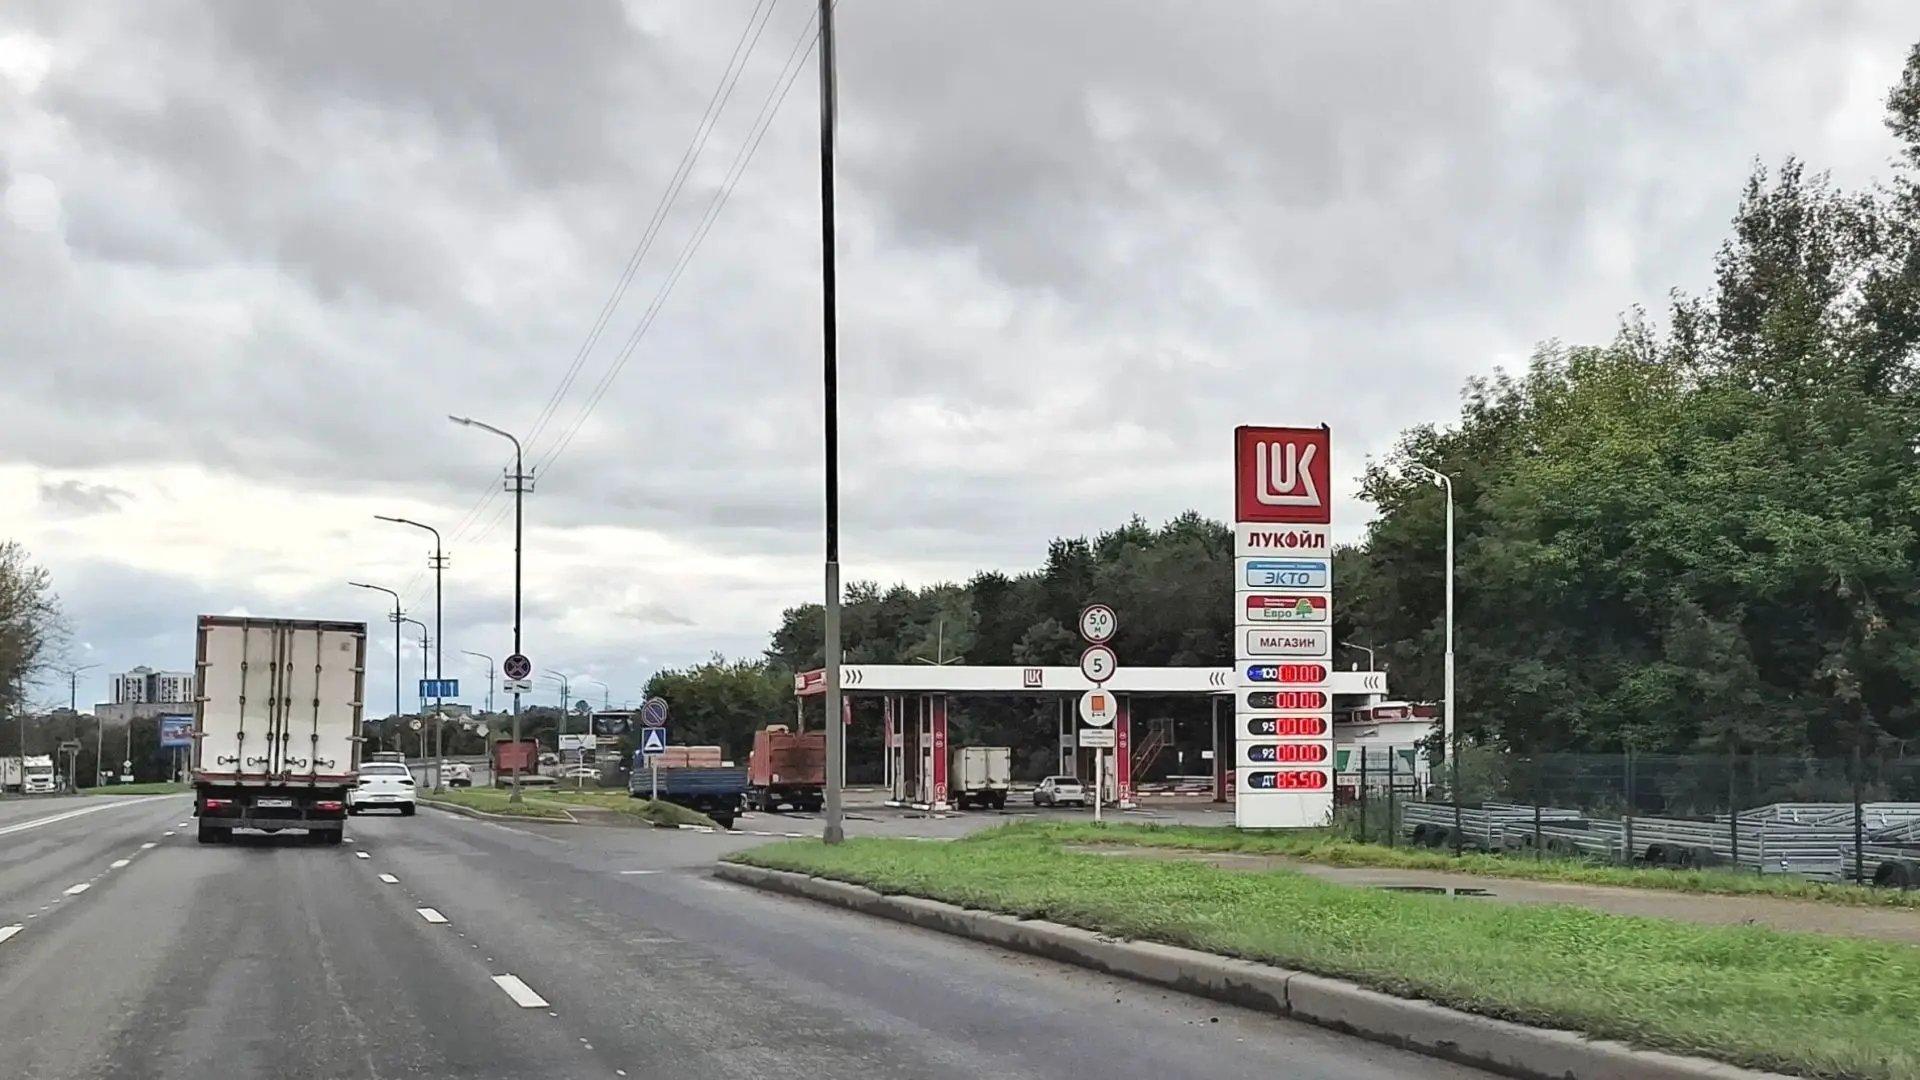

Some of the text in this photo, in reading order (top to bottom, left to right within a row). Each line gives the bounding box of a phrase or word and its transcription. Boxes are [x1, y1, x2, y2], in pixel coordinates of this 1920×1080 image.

[1248, 530, 1325, 548] ЛУКОЙЛ
[1264, 571, 1310, 584] ЭКТО
[1263, 608, 1292, 620] Евро
[1260, 637, 1315, 648] МАГАЗИН
[1092, 658, 1103, 673] 5
[1261, 668, 1278, 679] 100
[1262, 721, 1275, 732] 95
[1262, 748, 1275, 759] 92
[1262, 775, 1275, 787] ДТ
